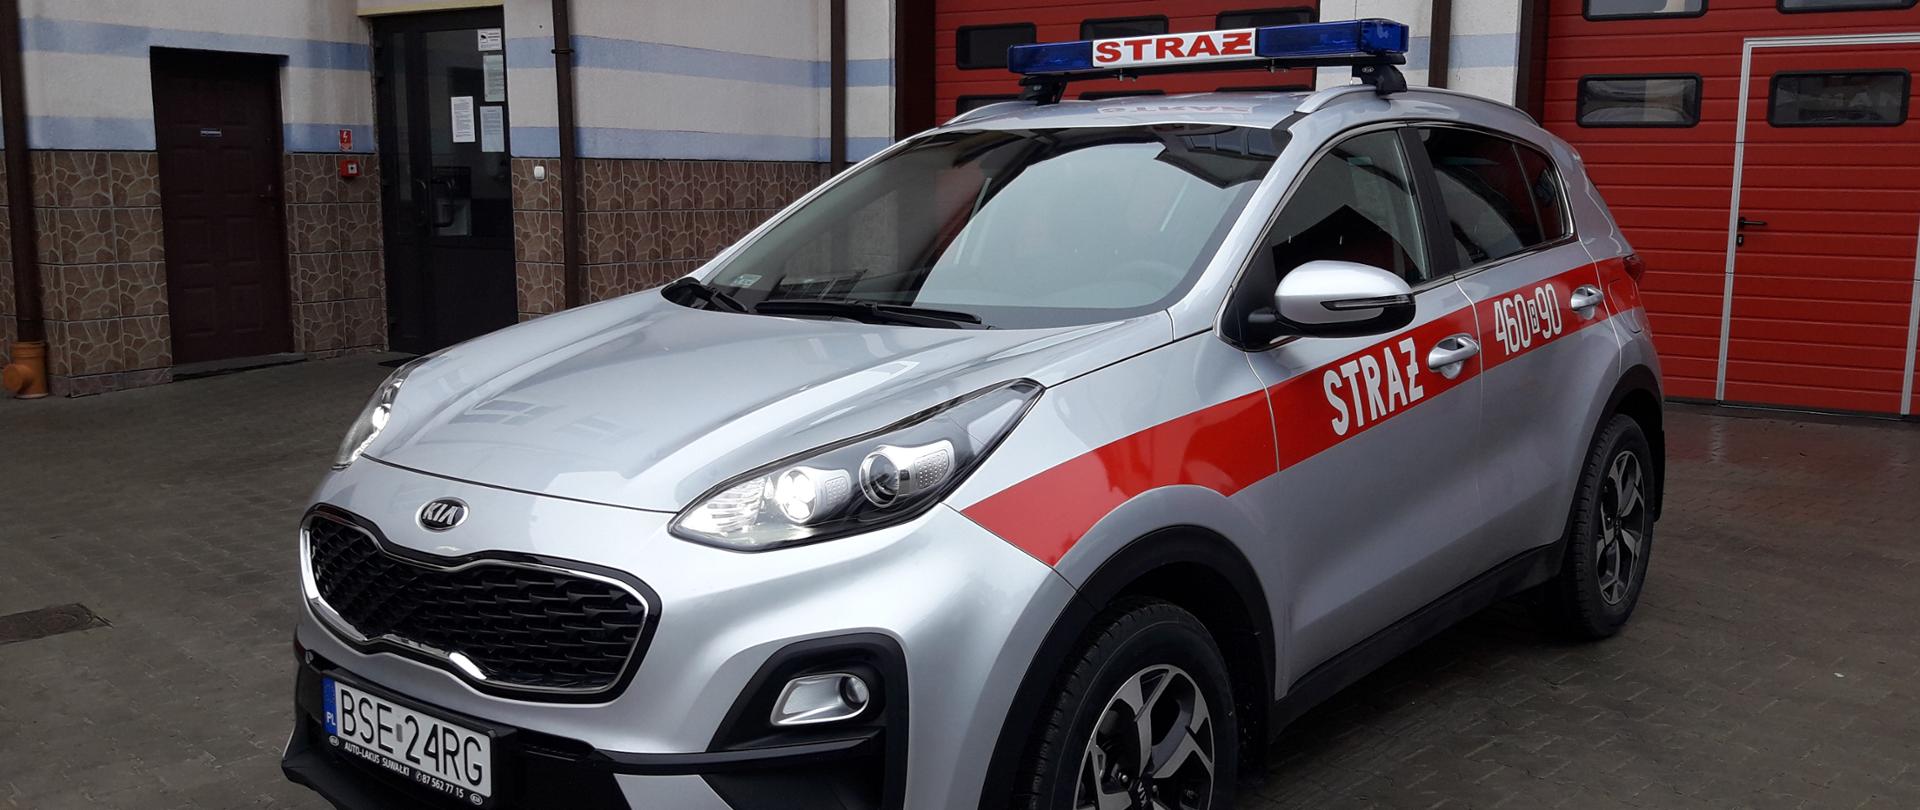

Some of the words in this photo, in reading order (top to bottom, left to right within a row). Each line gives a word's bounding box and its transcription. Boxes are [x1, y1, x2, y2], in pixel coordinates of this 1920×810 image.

[422, 502, 458, 526] KIA
[326, 711, 337, 726] PL
[340, 688, 395, 754] BSE
[404, 714, 483, 786] 24RG
